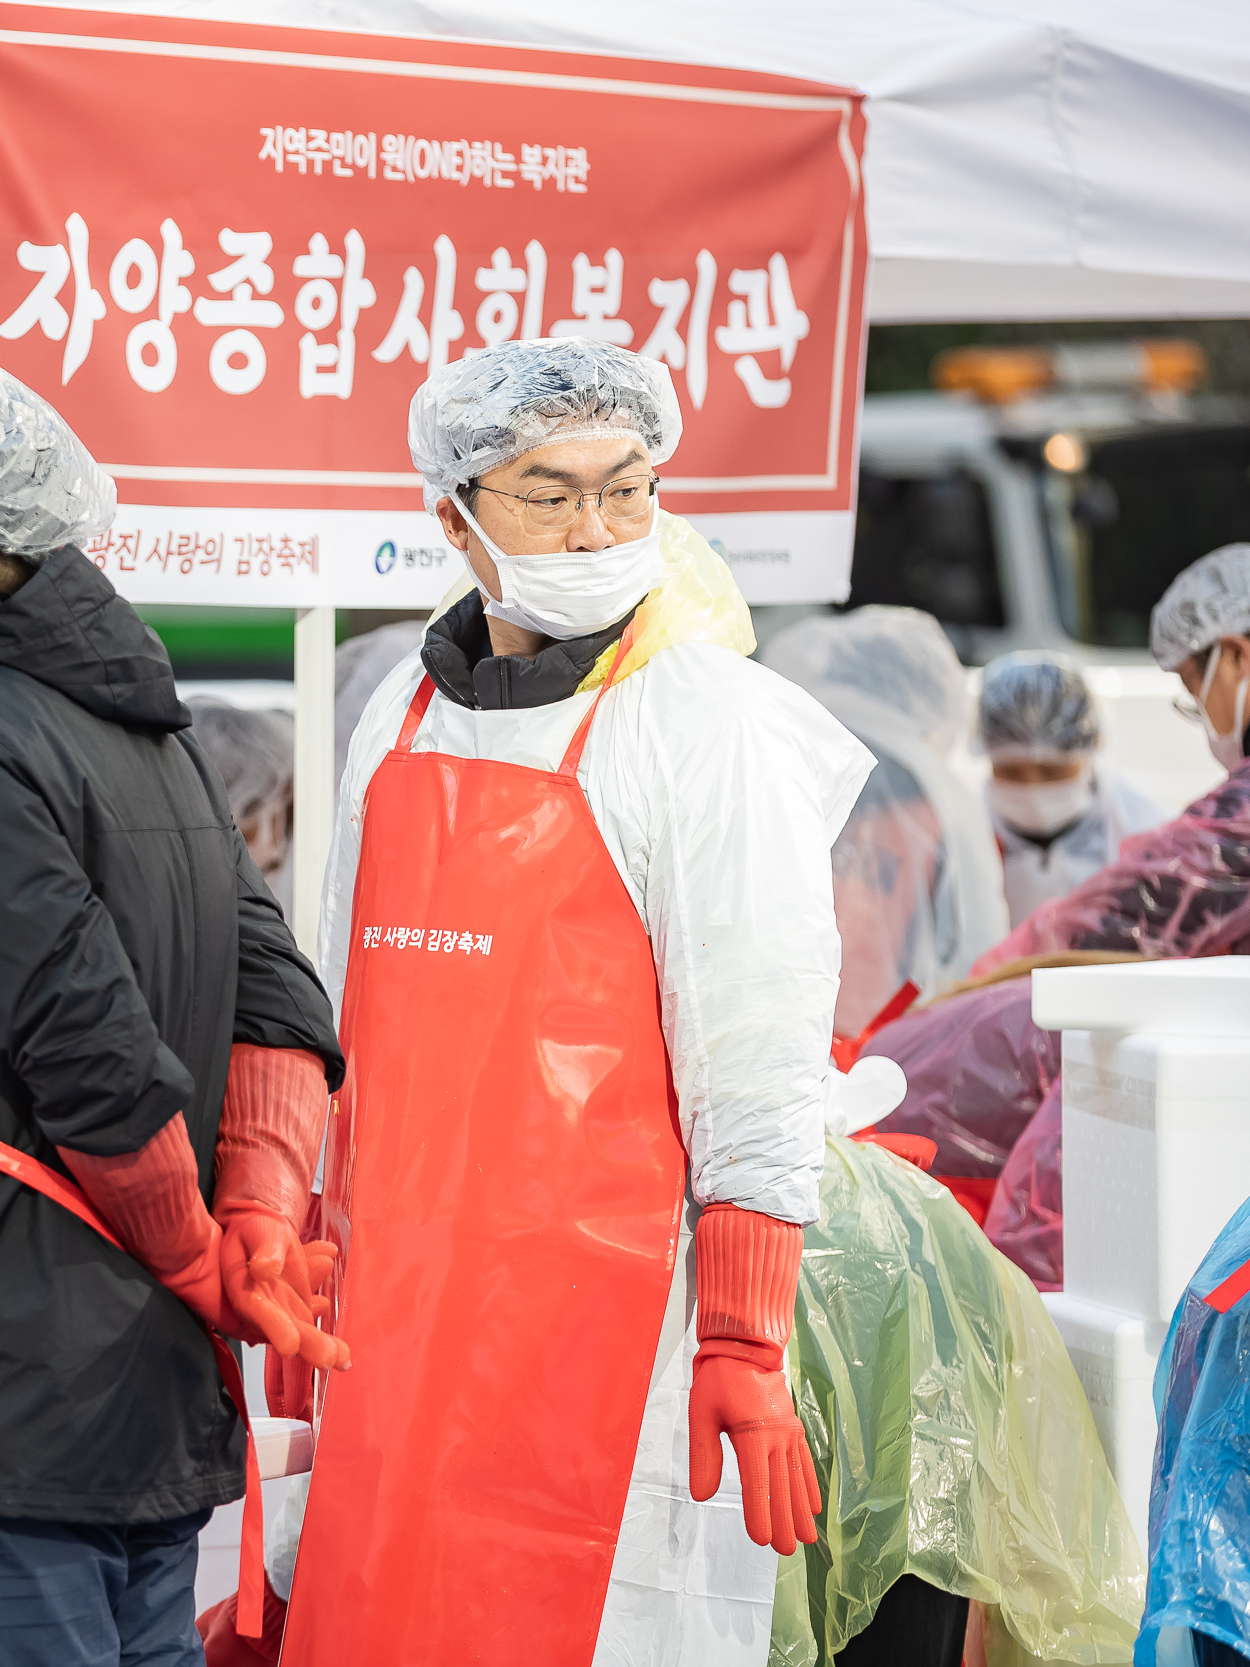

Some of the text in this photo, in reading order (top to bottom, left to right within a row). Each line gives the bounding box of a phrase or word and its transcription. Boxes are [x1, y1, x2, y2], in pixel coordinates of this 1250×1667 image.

[258, 125, 592, 194] 지역주민이 원(ONE)하는 복지관
[87, 528, 320, 577] 광진 사랑의 김장축제
[402, 546, 448, 569] 광진구
[363, 926, 493, 956] 광진 사랑의 김장축제
